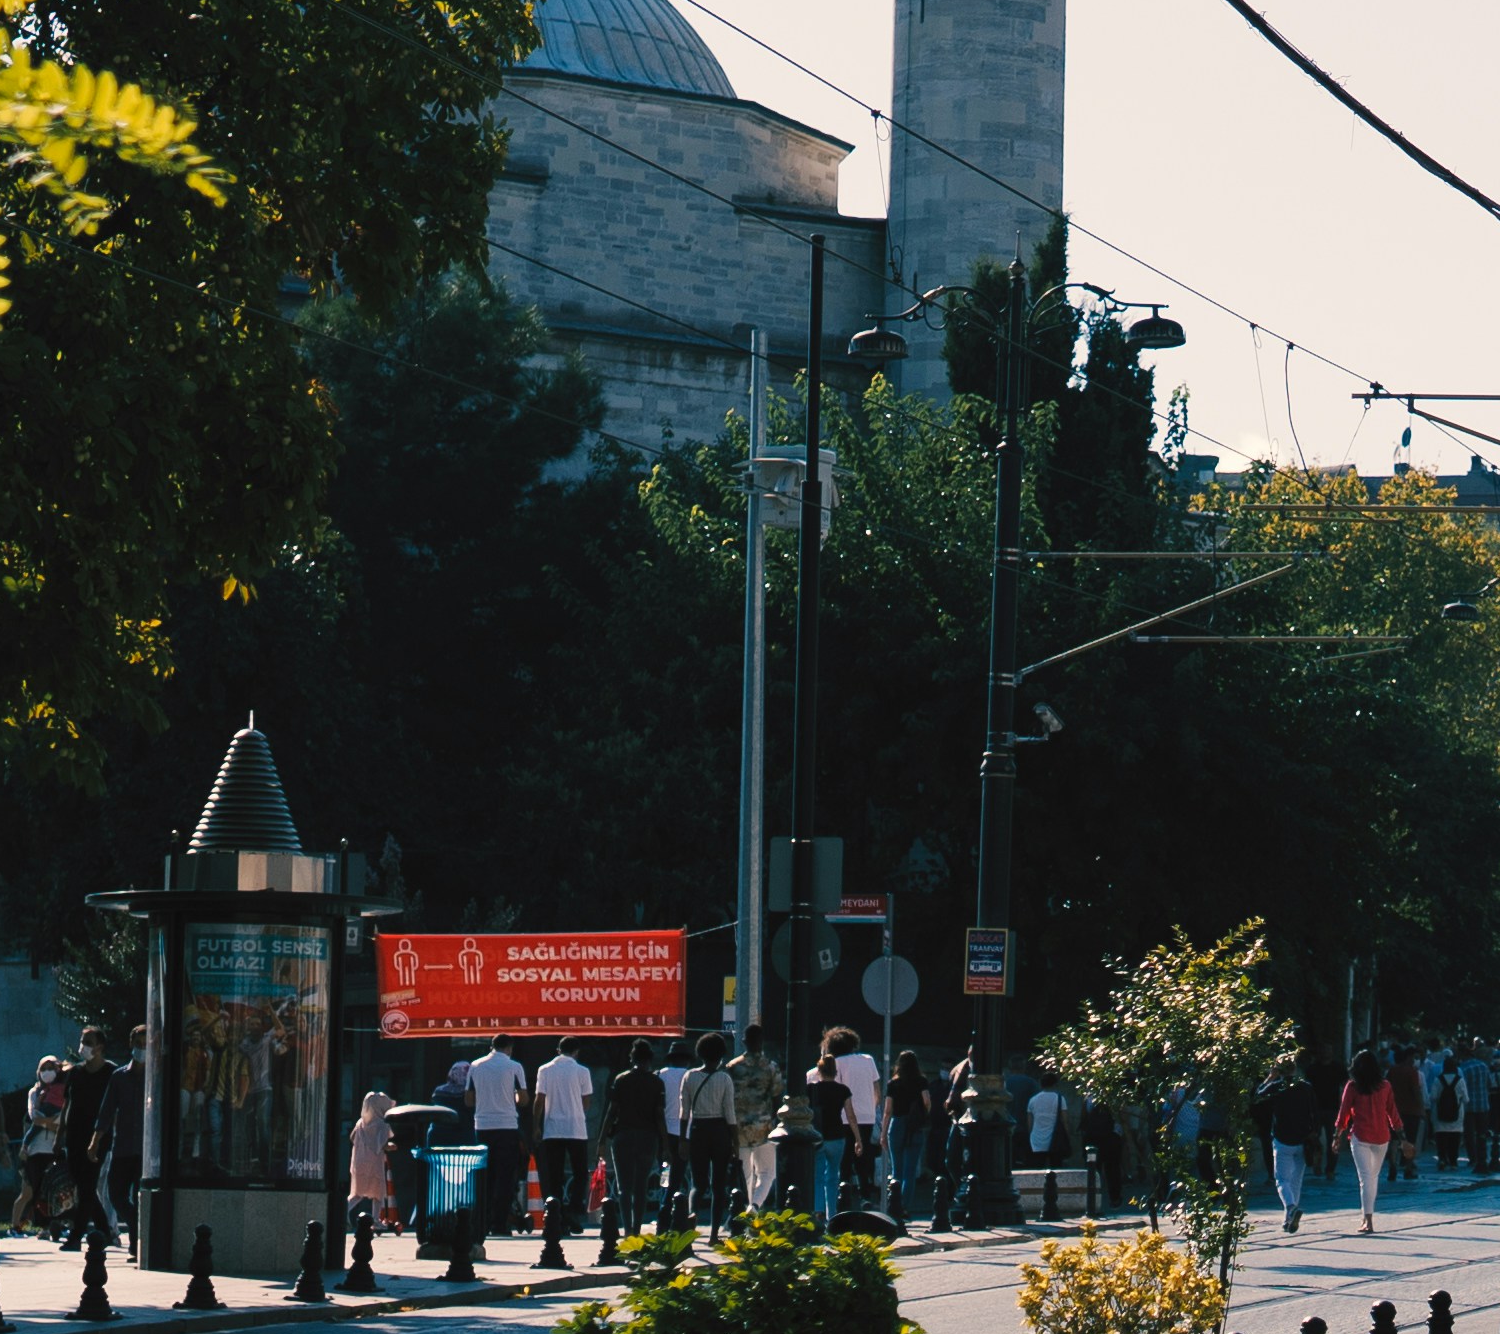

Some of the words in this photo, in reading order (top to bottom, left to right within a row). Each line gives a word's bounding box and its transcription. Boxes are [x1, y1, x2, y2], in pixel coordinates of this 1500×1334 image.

[197, 938, 268, 954] FUTBOL
[271, 938, 323, 956] SENSİZ
[506, 941, 622, 961] SAĞLIĞINIZ
[627, 940, 670, 964] İÇİN
[196, 955, 266, 971] OLMAZ!
[497, 967, 577, 983] SOSYAL
[582, 961, 682, 982] MESAFEYİ
[540, 986, 641, 1003] KORUYUN
[427, 1016, 500, 1028] FATİH
[520, 1014, 666, 1028] BELEDİYESİ
